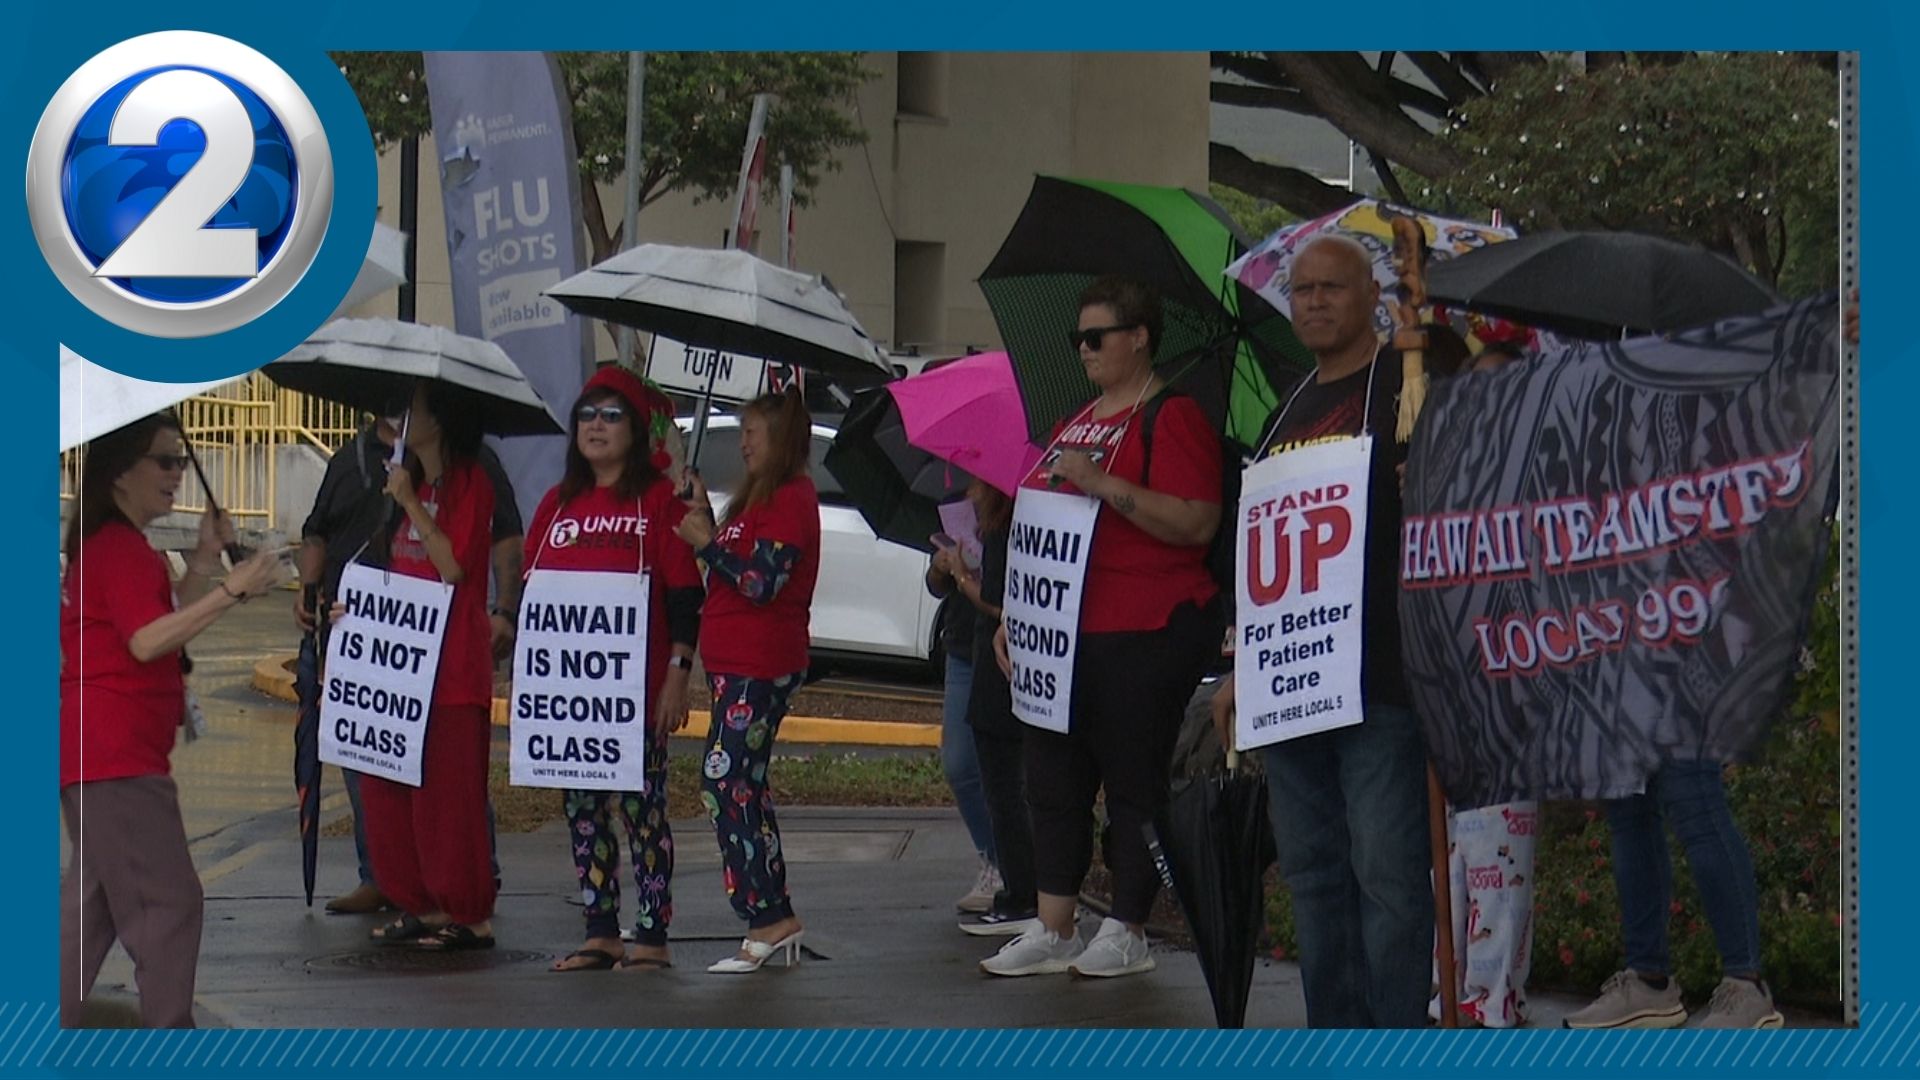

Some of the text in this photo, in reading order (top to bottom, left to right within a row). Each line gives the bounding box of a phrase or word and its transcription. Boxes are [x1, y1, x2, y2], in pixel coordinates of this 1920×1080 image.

[473, 177, 550, 240] FLU
[477, 233, 557, 275] SHOTS
[683, 347, 733, 382] TURN
[1246, 483, 1349, 523] STAND
[583, 515, 648, 536] UNITE
[1402, 510, 1526, 580] HAWAII
[1247, 505, 1352, 607] UP
[1008, 566, 1070, 611] IS NOT
[345, 588, 439, 634] HAWAII
[525, 603, 636, 635] HAWAII
[1244, 603, 1352, 646] For Better
[339, 631, 427, 674] IS NOT
[1006, 615, 1069, 658] SECOND
[1258, 634, 1334, 671] Patient
[526, 648, 630, 680] IS NOT
[1271, 670, 1320, 696] Care
[328, 678, 422, 722] SECOND
[517, 693, 636, 723] SECOND
[1252, 696, 1343, 731] UNITE HERE LOCAL 5
[335, 718, 407, 758] CLASS
[528, 735, 621, 764] CLASS
[337, 749, 357, 760] UNITE
[358, 754, 375, 765] HERE
[376, 758, 397, 771] LOCAL
[532, 768, 616, 780] UNITE HERE LOCAL 5
